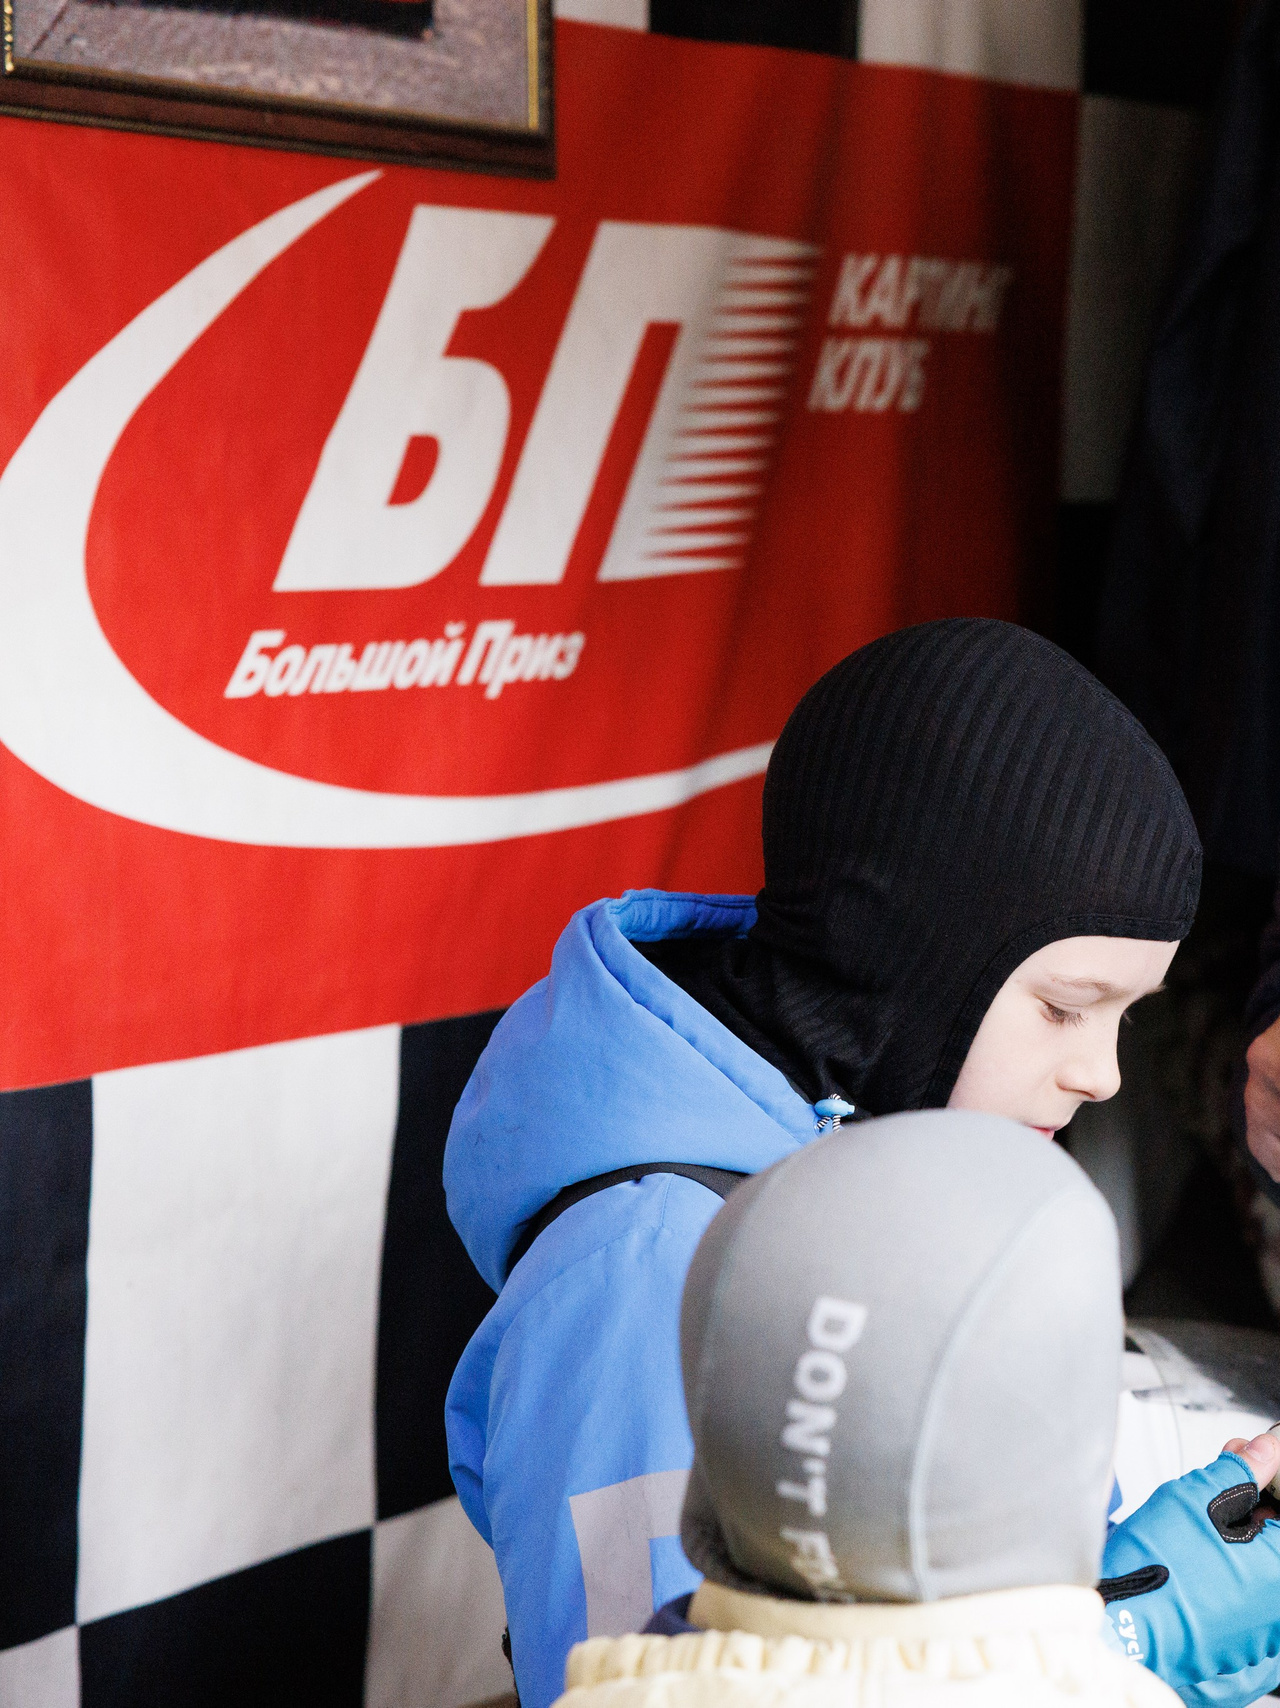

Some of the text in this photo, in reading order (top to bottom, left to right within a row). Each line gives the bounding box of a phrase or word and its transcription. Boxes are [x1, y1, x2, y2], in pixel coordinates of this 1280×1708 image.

[273, 204, 820, 593] БП
[807, 338, 929, 413] КЛУБ
[224, 619, 585, 700] Большой Приз
[776, 1296, 868, 1517] DON'T
